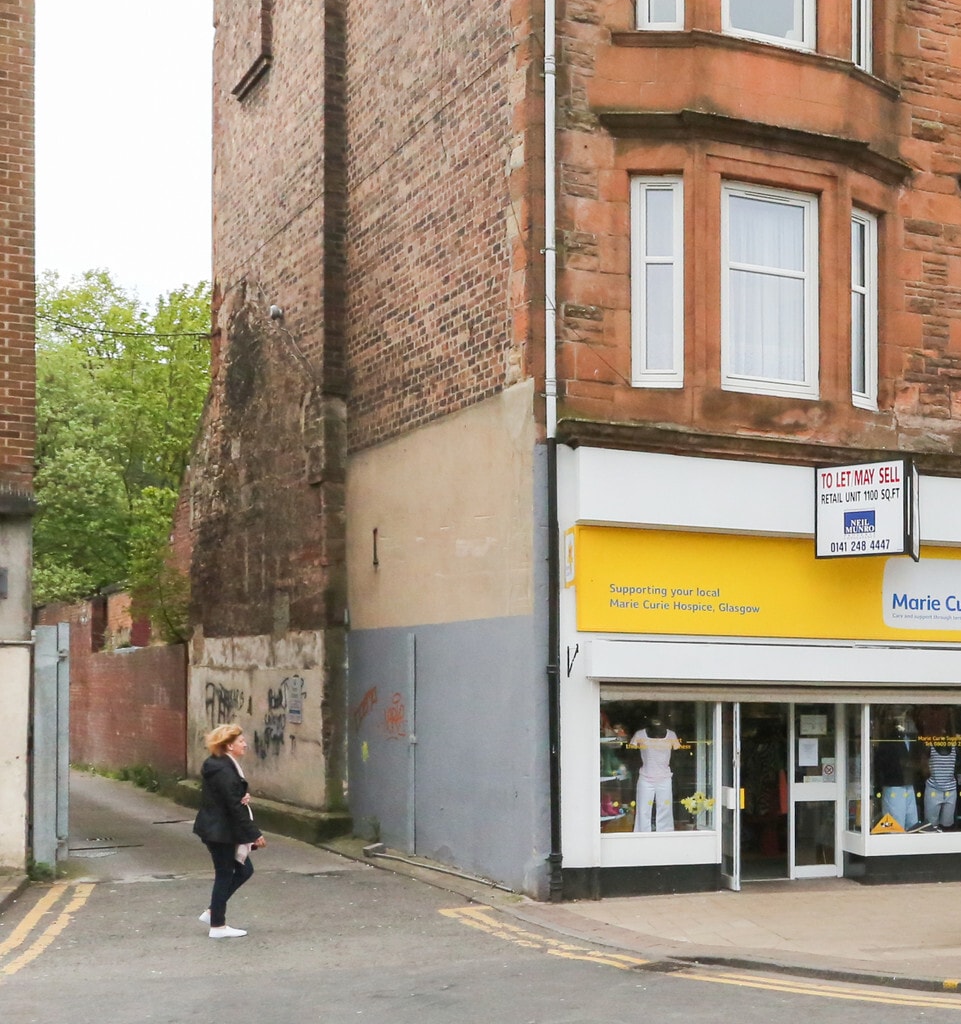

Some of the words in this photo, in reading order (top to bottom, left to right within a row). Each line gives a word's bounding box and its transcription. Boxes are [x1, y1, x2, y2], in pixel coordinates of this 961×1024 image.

[821, 472, 833, 488] TO
[878, 466, 900, 484] SELL
[821, 492, 843, 505] RETAIL
[845, 490, 861, 503] UNIT
[863, 489, 879, 501] 1100
[845, 524, 875, 534] MUNRO
[850, 518, 870, 527] NEIL
[830, 541, 847, 553] 0141
[851, 540, 867, 552] 248
[869, 539, 890, 550] 4447
[609, 583, 667, 597] Supporting
[671, 587, 693, 598] your
[696, 587, 720, 597] local
[609, 598, 639, 609] Marie
[643, 599, 670, 610] Curie
[674, 601, 715, 614] Hospice,
[718, 602, 760, 615] Glasgow
[892, 593, 941, 611] Marie
